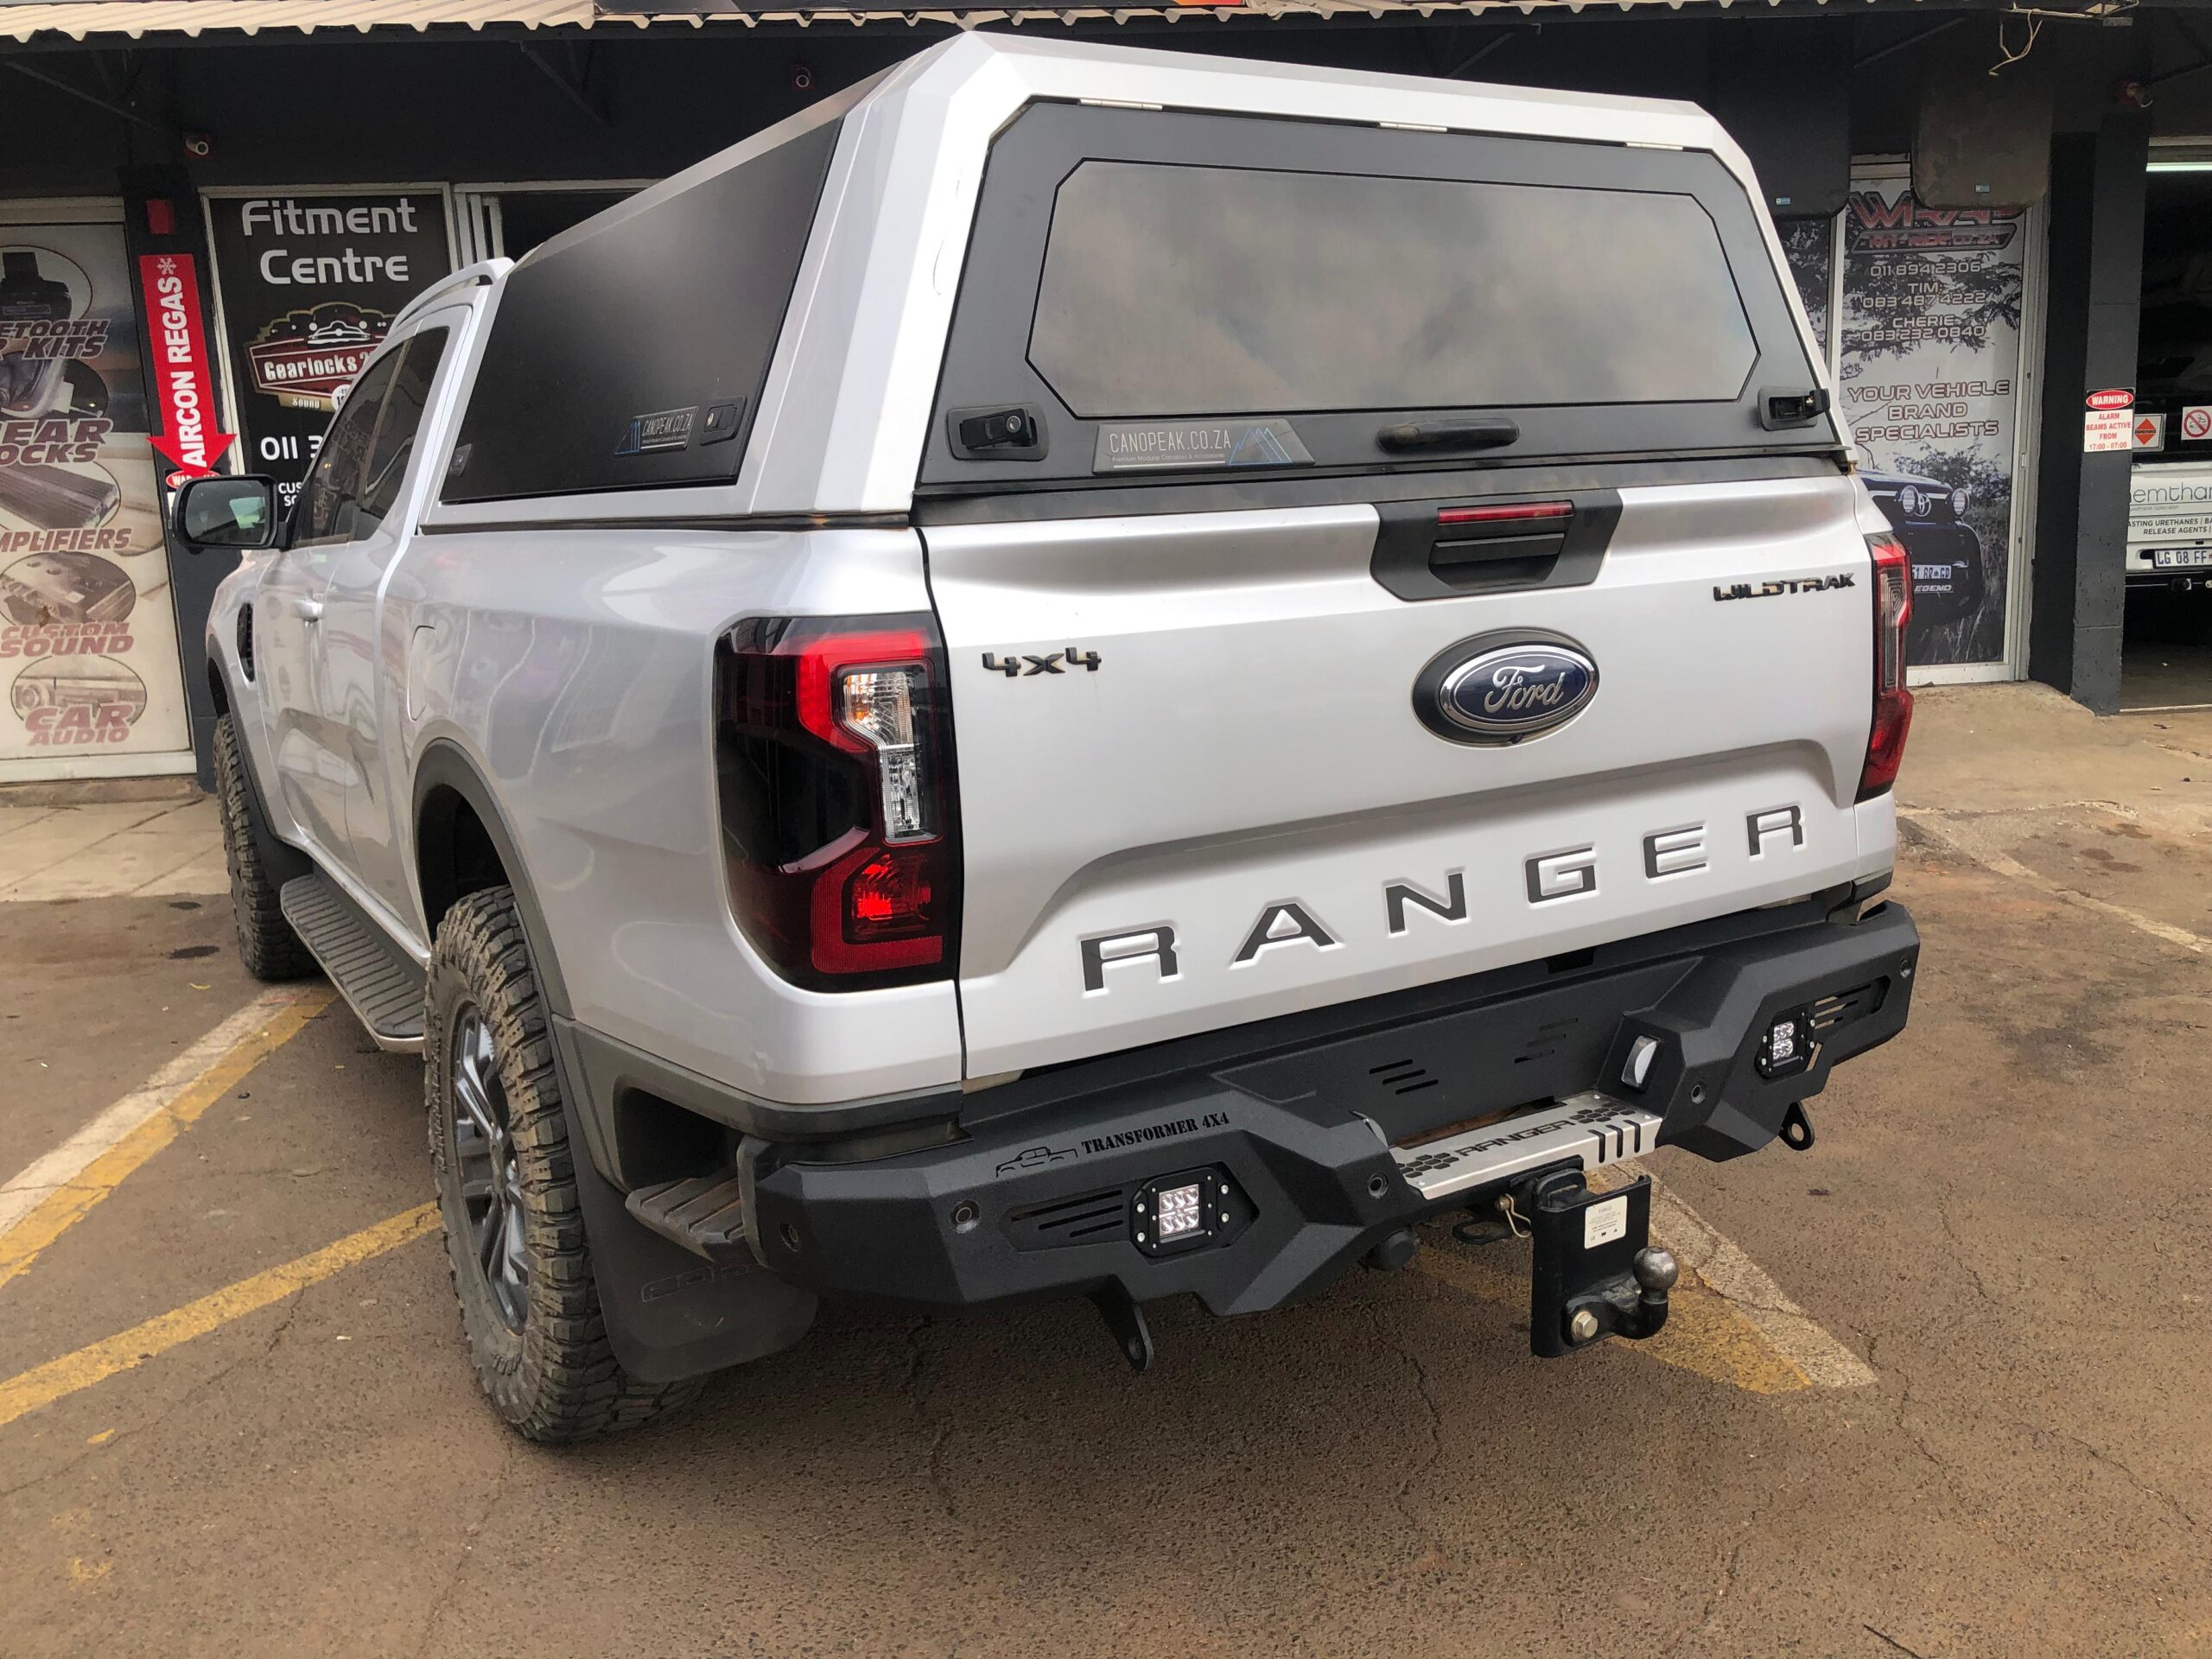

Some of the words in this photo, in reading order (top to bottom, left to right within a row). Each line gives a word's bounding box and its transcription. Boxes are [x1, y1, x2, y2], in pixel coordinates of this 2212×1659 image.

[242, 198, 417, 236] Fitment
[260, 248, 409, 284] Centre
[1871, 265, 1891, 276] 011
[1896, 263, 1931, 276] 894
[1935, 262, 1981, 274] 2306
[1908, 282, 1943, 294] TIM:
[1862, 296, 1897, 308] 083
[1940, 293, 1986, 305] 4222
[157, 276, 192, 364] REGAS
[1892, 315, 1955, 327] CHERIE
[1861, 331, 1897, 342] 083
[1901, 328, 1933, 340] 232
[1937, 326, 1985, 338] 0840
[22, 335, 107, 359] KITS
[264, 354, 358, 381] Gearlocks
[1847, 385, 1910, 402] YOUR
[1915, 379, 2010, 399] VEHICLE
[2091, 395, 2128, 405] WARNING
[171, 371, 207, 468] AIRCON
[1888, 402, 1967, 421] BRAND
[0, 418, 113, 445] EAR
[1109, 429, 1231, 453] CANOPEAK.CO.ZA
[1855, 421, 1999, 443] SPECIALISTS
[2155, 518, 2198, 526] URETHANES
[2156, 551, 2171, 564] LG
[2176, 551, 2190, 563] 08
[2195, 550, 2207, 563] FF
[1713, 572, 1855, 601] WILDTRAK
[2, 623, 130, 640] CUSTOM
[0, 635, 134, 658] SOUND
[1484, 664, 1566, 714] Ford
[24, 702, 134, 731] CAR
[28, 727, 130, 747] AUDIO
[1079, 804, 1803, 995] RANGER
[1081, 1117, 1198, 1154] TRANSFORMER
[1202, 1111, 1230, 1127] 4X4
[1455, 1120, 1576, 1157] RANGER
